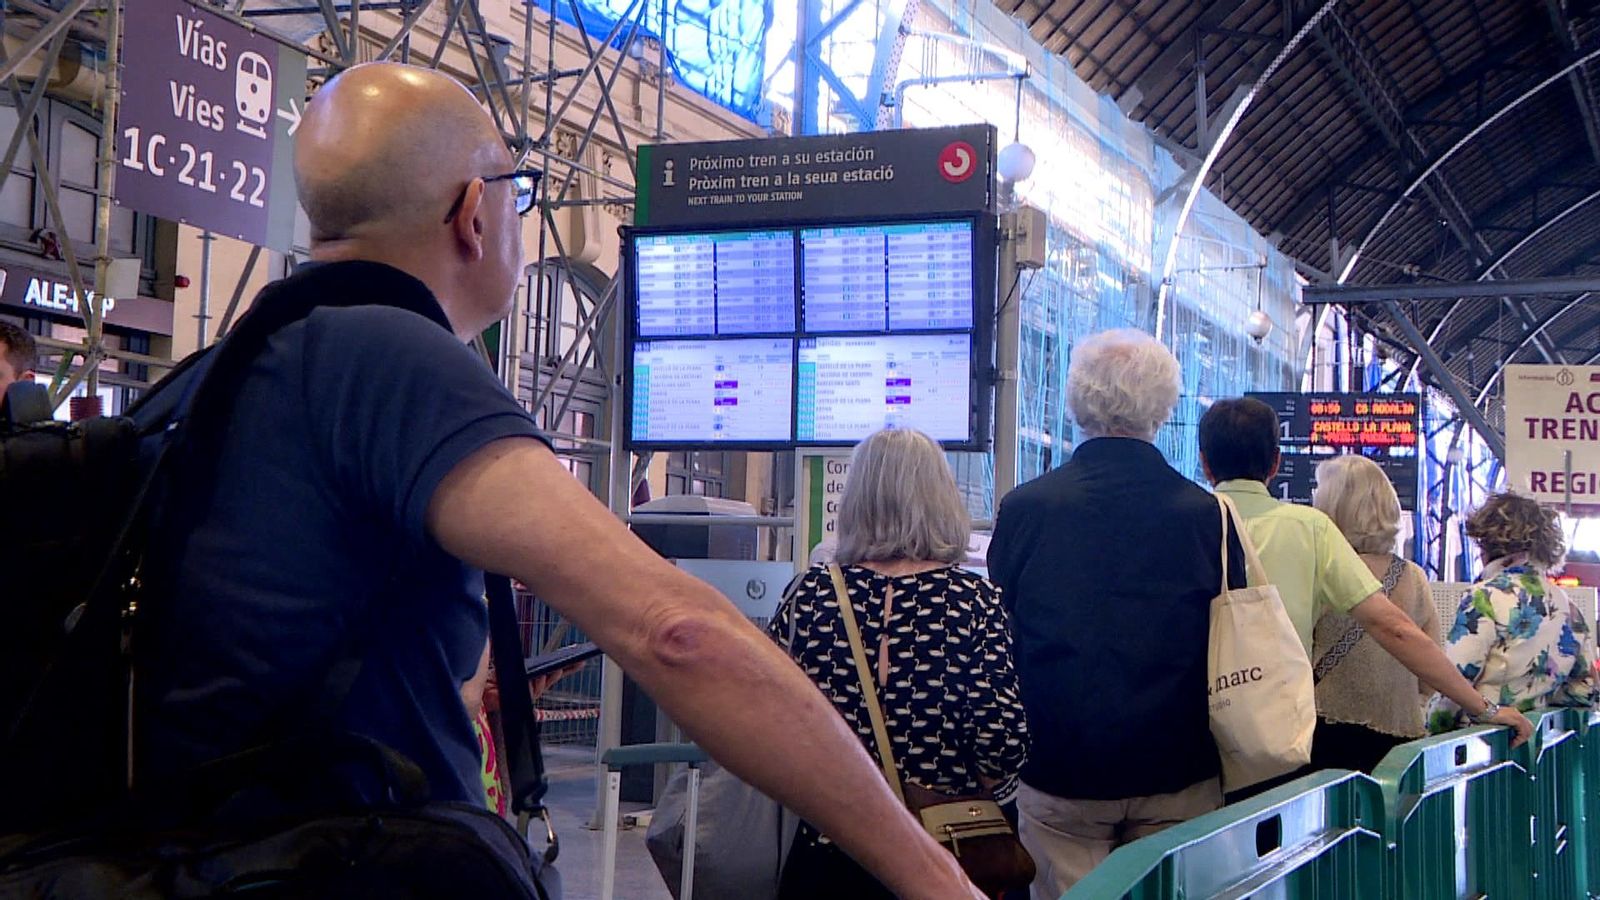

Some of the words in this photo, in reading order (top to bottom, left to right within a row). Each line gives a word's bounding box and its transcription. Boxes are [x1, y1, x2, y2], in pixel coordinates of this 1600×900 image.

[176, 14, 227, 72] Vías
[169, 80, 225, 131] Vies
[689, 155, 744, 172] Próximo
[749, 153, 777, 168] tren
[782, 154, 790, 166] a
[794, 152, 810, 165] su
[815, 146, 875, 163] estación
[688, 174, 736, 191] Pròxim
[740, 172, 769, 188] tren
[774, 173, 782, 186] a
[787, 169, 800, 185] la
[804, 171, 838, 185] seua
[842, 164, 894, 182] estació
[688, 195, 708, 206] NEXT
[709, 194, 733, 205] TRAIN
[735, 193, 745, 204] TO
[747, 192, 769, 203] YOUR
[770, 190, 803, 202] STATION
[1280, 421, 1294, 442] 1
[1363, 421, 1376, 433] LA
[1524, 418, 1598, 441] TREN
[826, 480, 844, 493] de
[1278, 482, 1293, 502] 1
[1531, 471, 1600, 495] REGI
